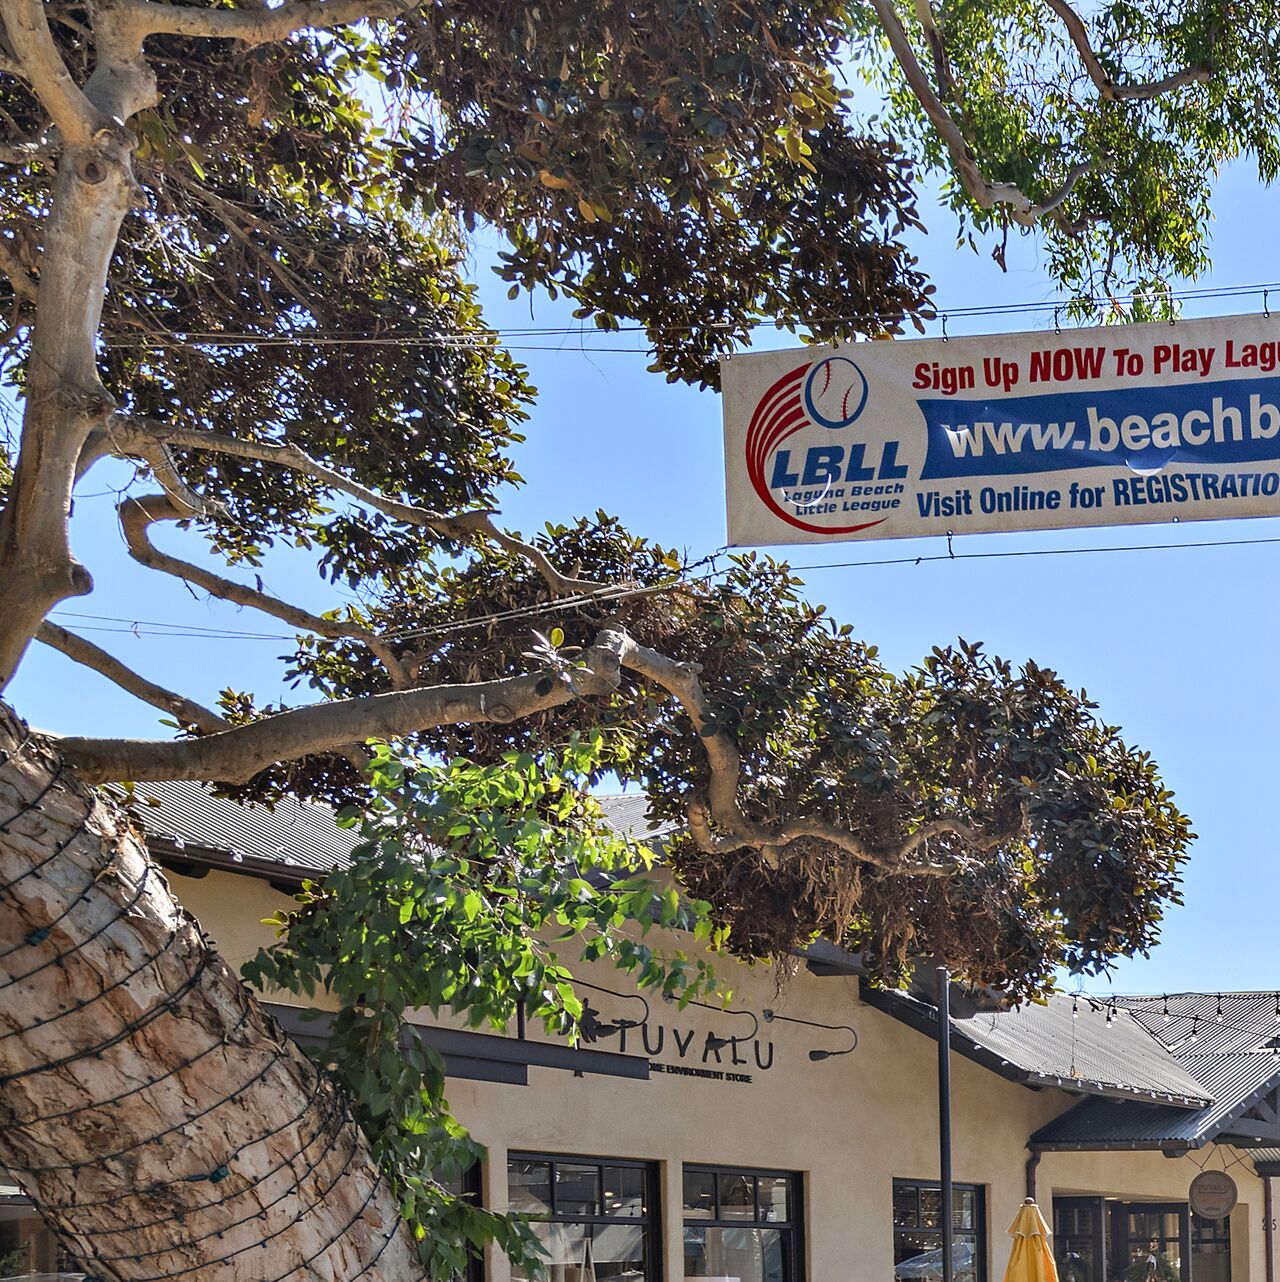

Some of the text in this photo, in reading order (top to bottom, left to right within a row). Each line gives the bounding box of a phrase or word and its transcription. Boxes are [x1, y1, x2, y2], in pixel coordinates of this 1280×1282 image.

[912, 362, 975, 396] Sign
[983, 356, 1019, 392] Up
[1029, 347, 1106, 382] NOW
[1113, 348, 1144, 377] To
[1154, 343, 1216, 377] Play
[771, 441, 908, 489] LBLL
[784, 483, 904, 503] Laguna Beach
[796, 498, 900, 516] Little League
[916, 489, 972, 518] Visit
[980, 485, 1060, 514] Online
[1069, 482, 1105, 508] for
[611, 1018, 773, 1070] TUVALU
[648, 1063, 665, 1073] OME
[725, 1072, 752, 1084] STORE
